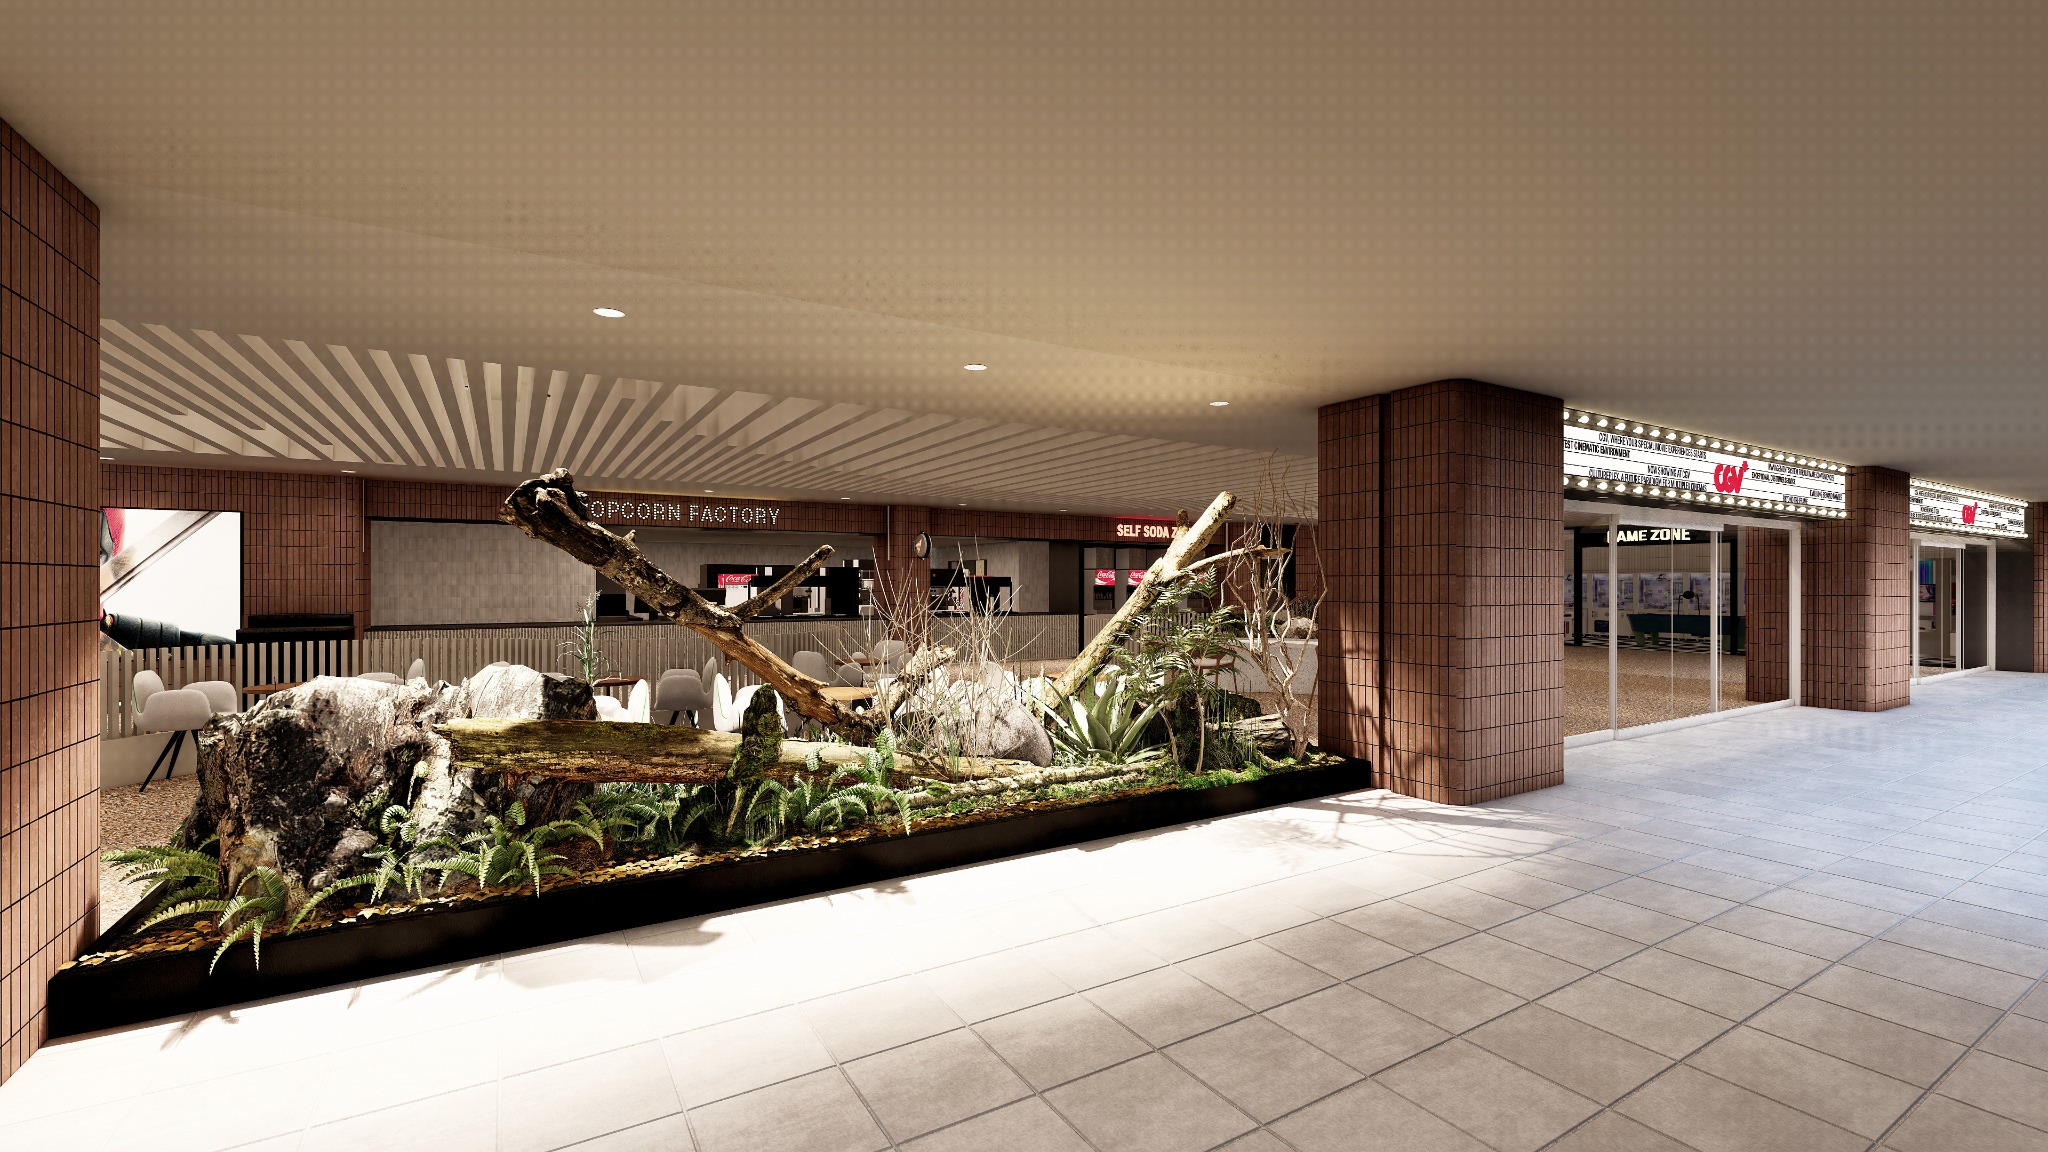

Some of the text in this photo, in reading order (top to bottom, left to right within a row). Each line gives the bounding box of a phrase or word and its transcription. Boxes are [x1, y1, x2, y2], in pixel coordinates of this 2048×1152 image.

[1713, 460, 1748, 493] CGV
[590, 500, 780, 525] OPCORN FACTORY
[1116, 524, 1141, 537] SELF
[1143, 525, 1169, 538] SODA
[1649, 528, 1691, 541] ZONE
